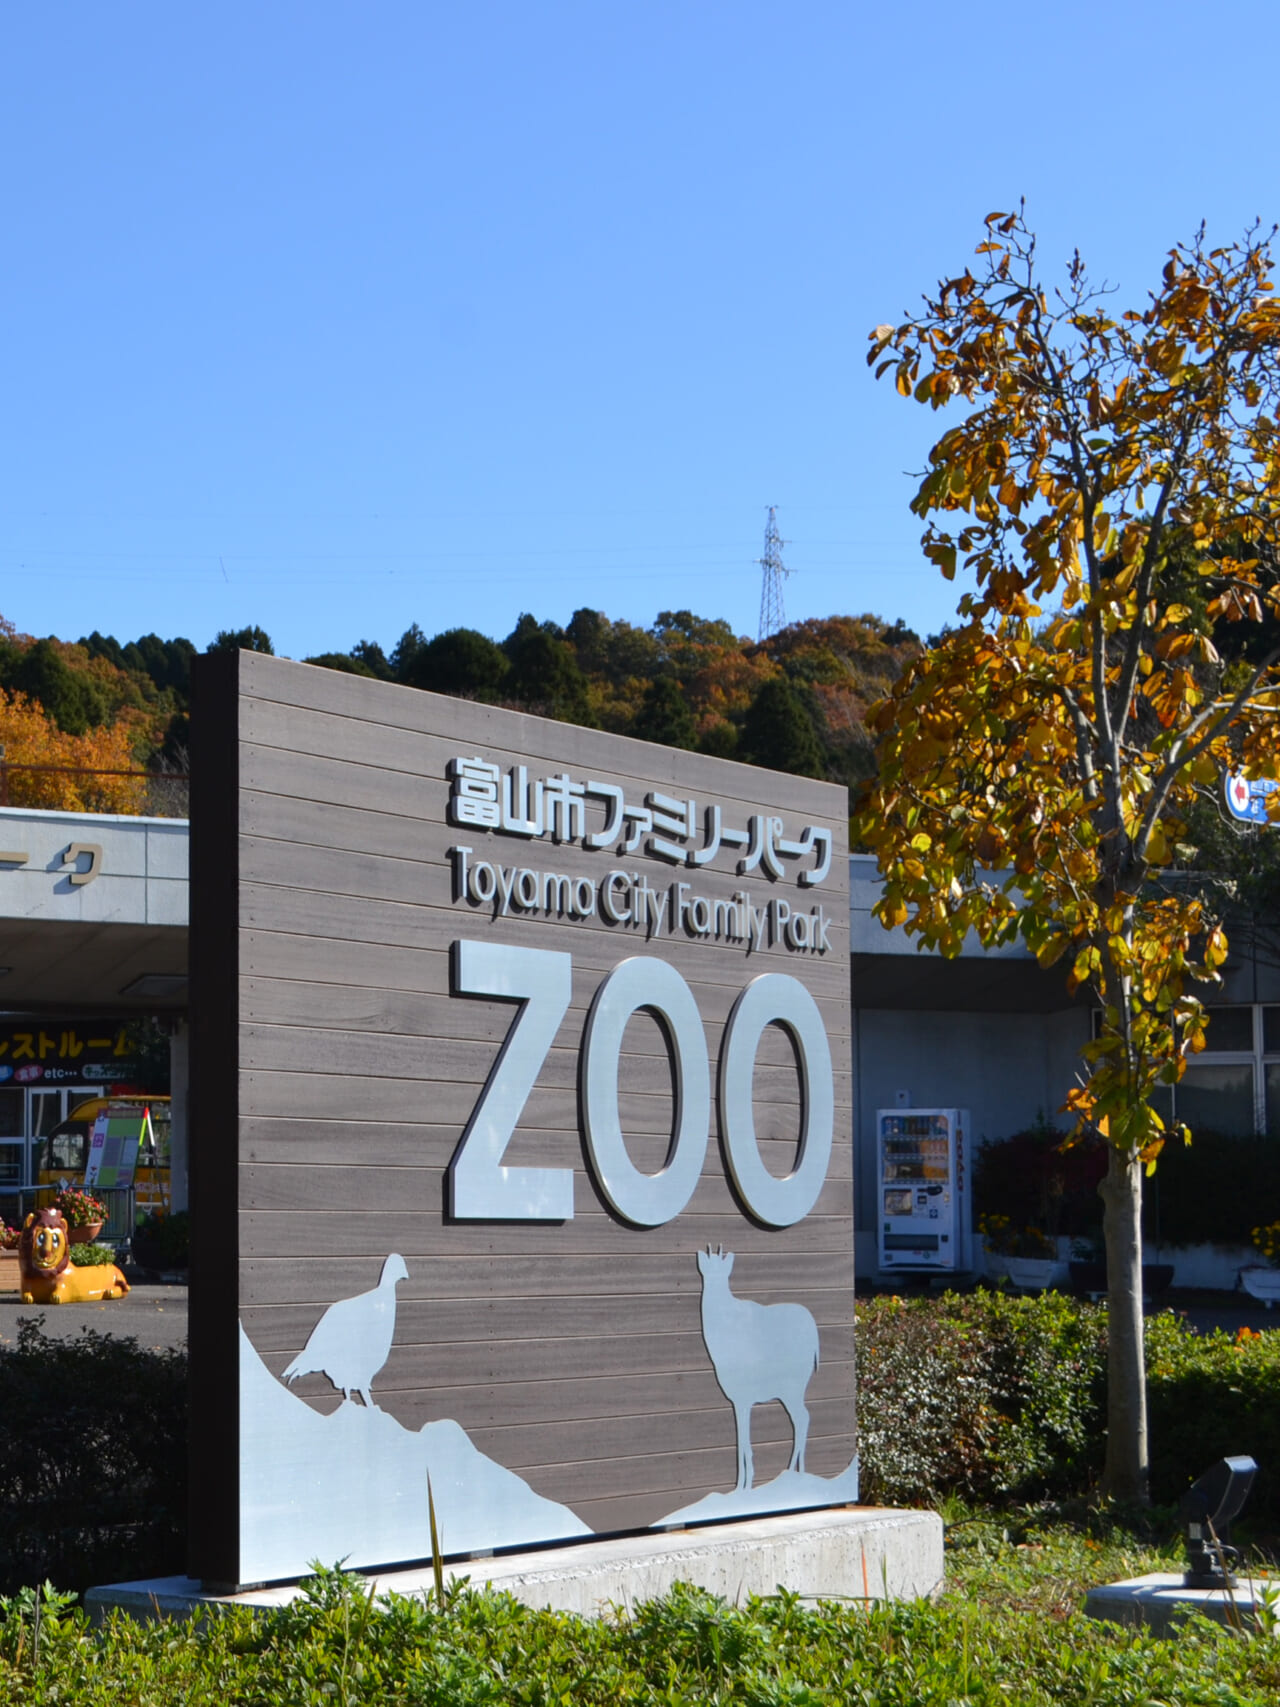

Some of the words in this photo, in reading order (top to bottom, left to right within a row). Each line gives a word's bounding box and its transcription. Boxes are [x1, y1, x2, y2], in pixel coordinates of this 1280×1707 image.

[452, 756, 833, 884] 富山市ファミリーパーク
[455, 845, 596, 917] Toyama
[604, 870, 669, 936] City
[676, 881, 768, 951] Family
[774, 898, 833, 951] Park
[452, 938, 835, 1227] ZOO
